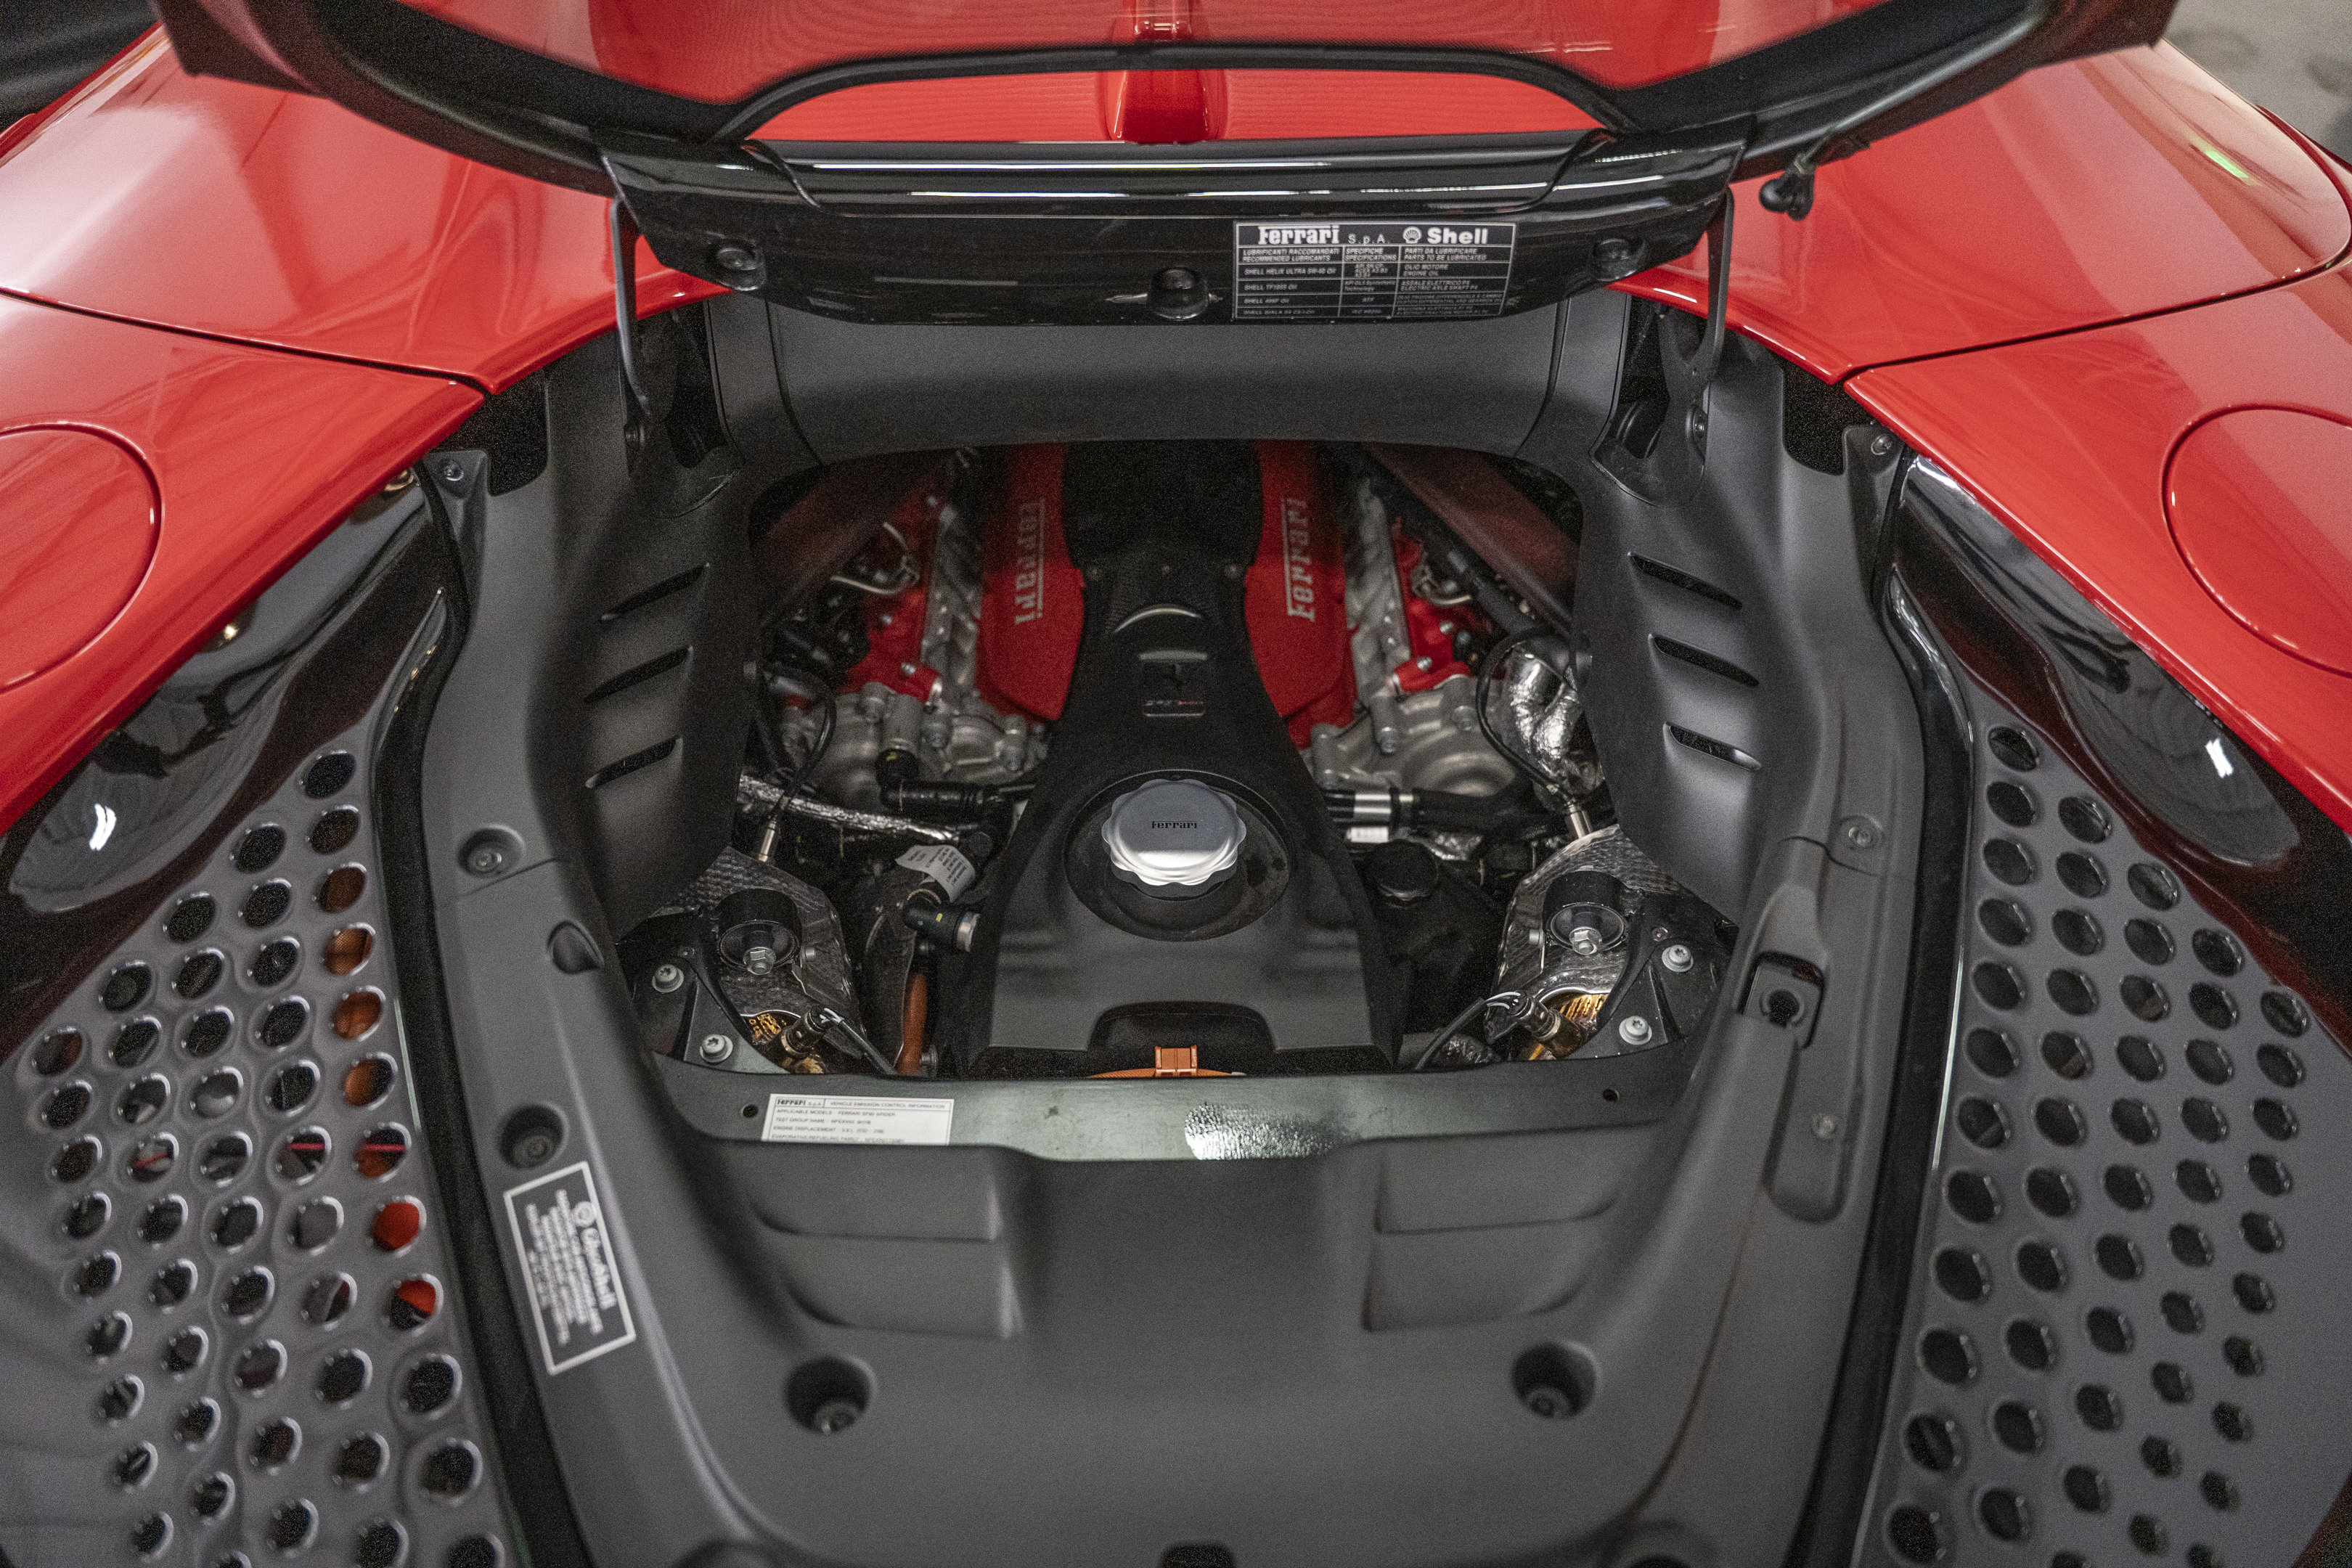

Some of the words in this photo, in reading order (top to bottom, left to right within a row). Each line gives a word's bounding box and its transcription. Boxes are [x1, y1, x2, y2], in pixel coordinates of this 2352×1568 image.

[1257, 225, 1340, 245] Ferrari
[1426, 227, 1488, 244] Shell
[1281, 496, 1315, 623] Ferrari
